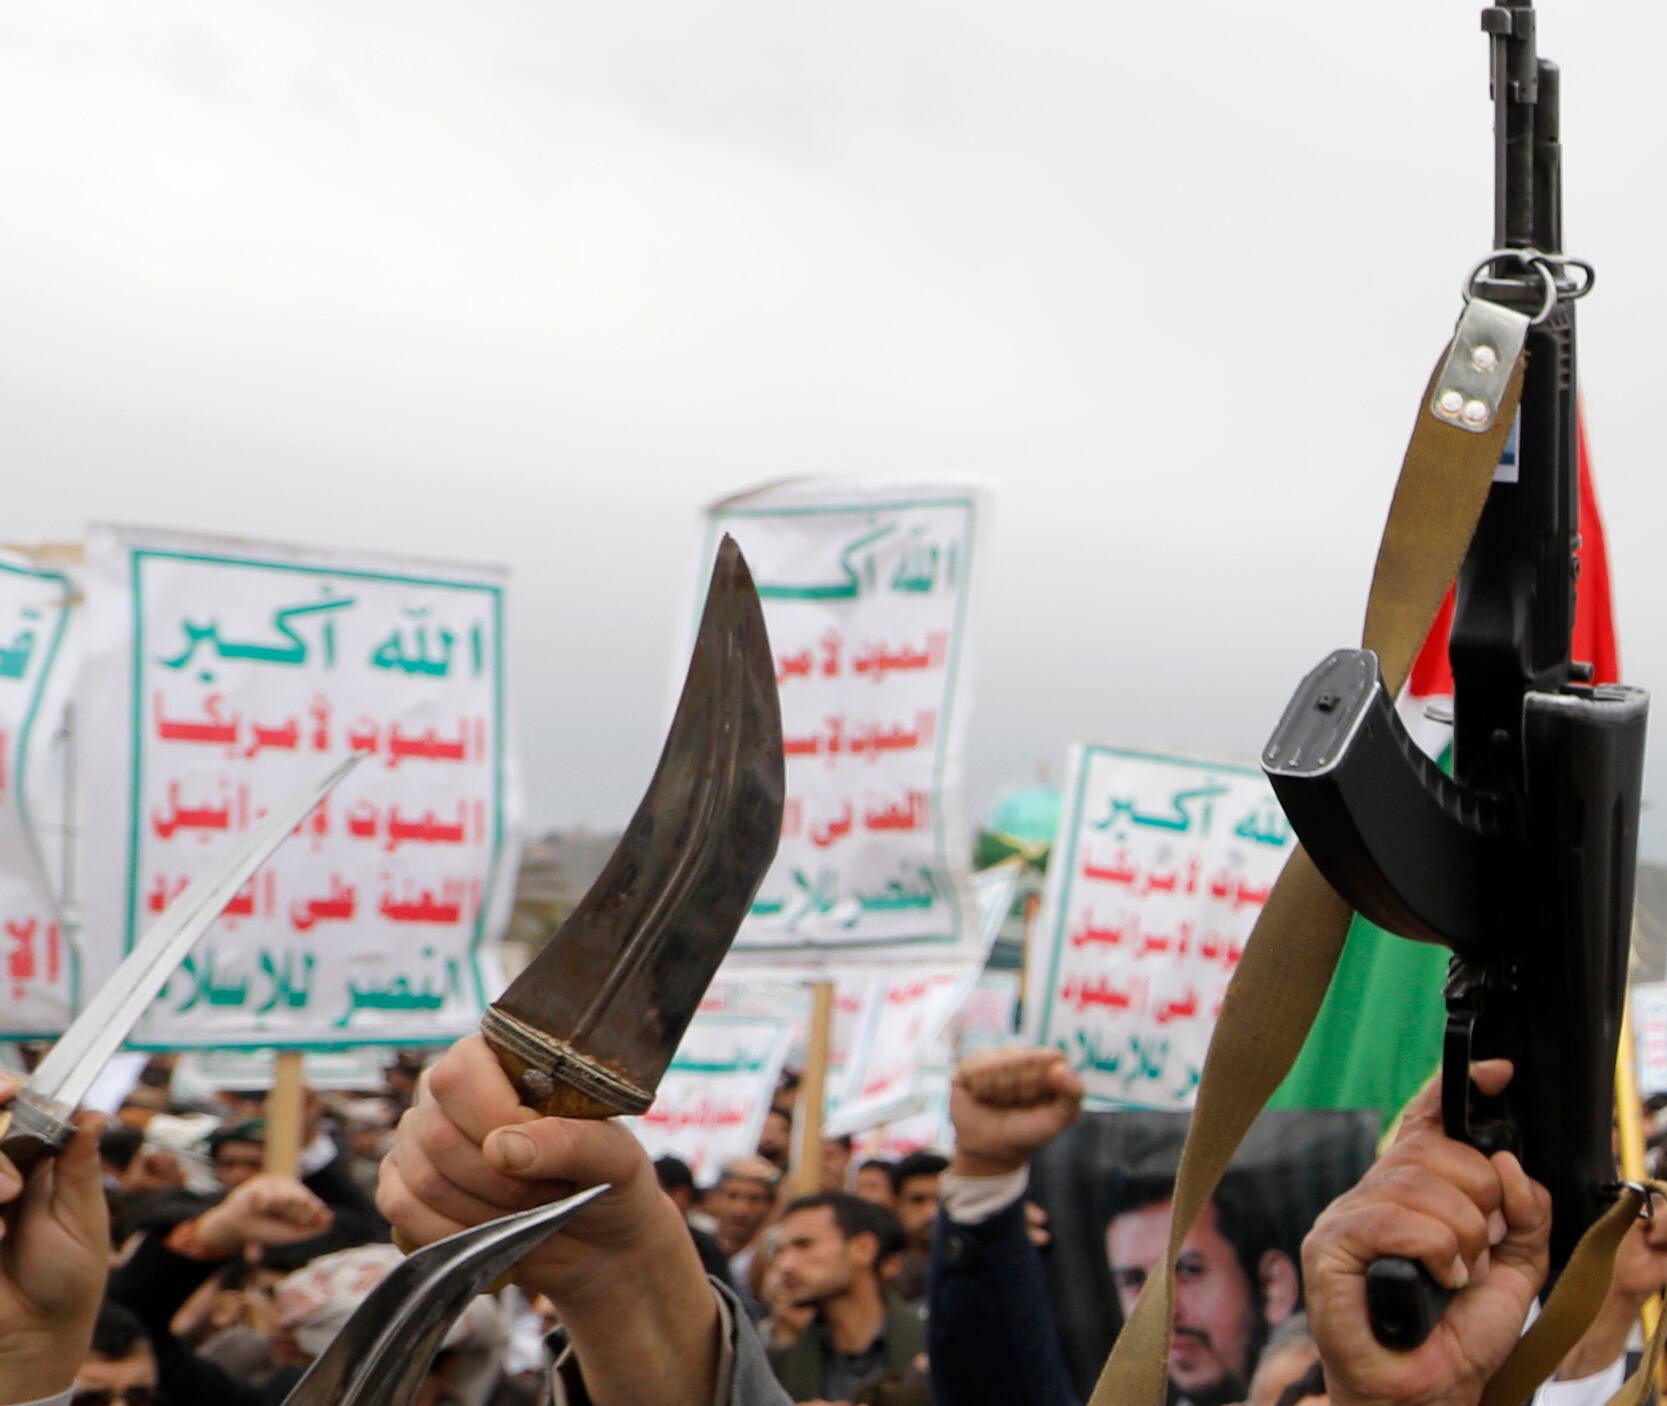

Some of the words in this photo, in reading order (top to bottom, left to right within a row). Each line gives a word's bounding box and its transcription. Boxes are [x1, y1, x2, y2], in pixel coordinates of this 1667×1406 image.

[756, 513, 898, 600] أك
[153, 583, 357, 682] أكبر
[370, 605, 484, 678] الله
[153, 688, 331, 760] لأمريكا
[347, 714, 485, 769] الموت
[152, 776, 330, 852] لإائيل
[346, 798, 485, 852] الموت
[1088, 774, 1232, 842] أكبر
[147, 869, 276, 931] اليد
[291, 871, 357, 932] على
[378, 870, 483, 924] اللعنة
[333, 945, 461, 1029] النصر
